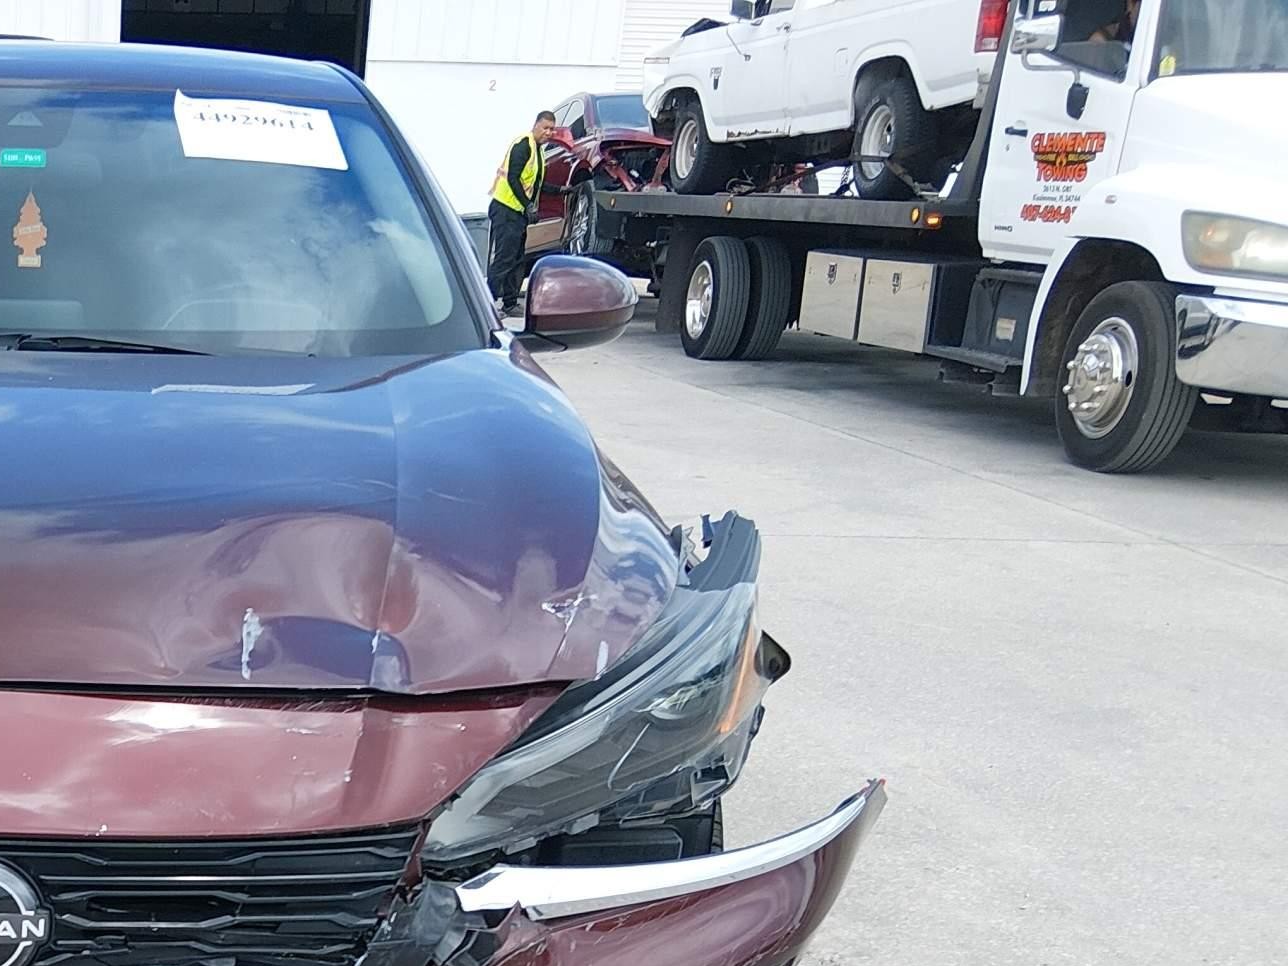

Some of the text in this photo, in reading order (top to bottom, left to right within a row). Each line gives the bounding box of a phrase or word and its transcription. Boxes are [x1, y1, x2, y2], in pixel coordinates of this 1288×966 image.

[488, 79, 497, 91] 2
[194, 111, 314, 131] 44929614
[1031, 131, 1107, 153] CLEMENTE
[1036, 162, 1088, 182] TOWING
